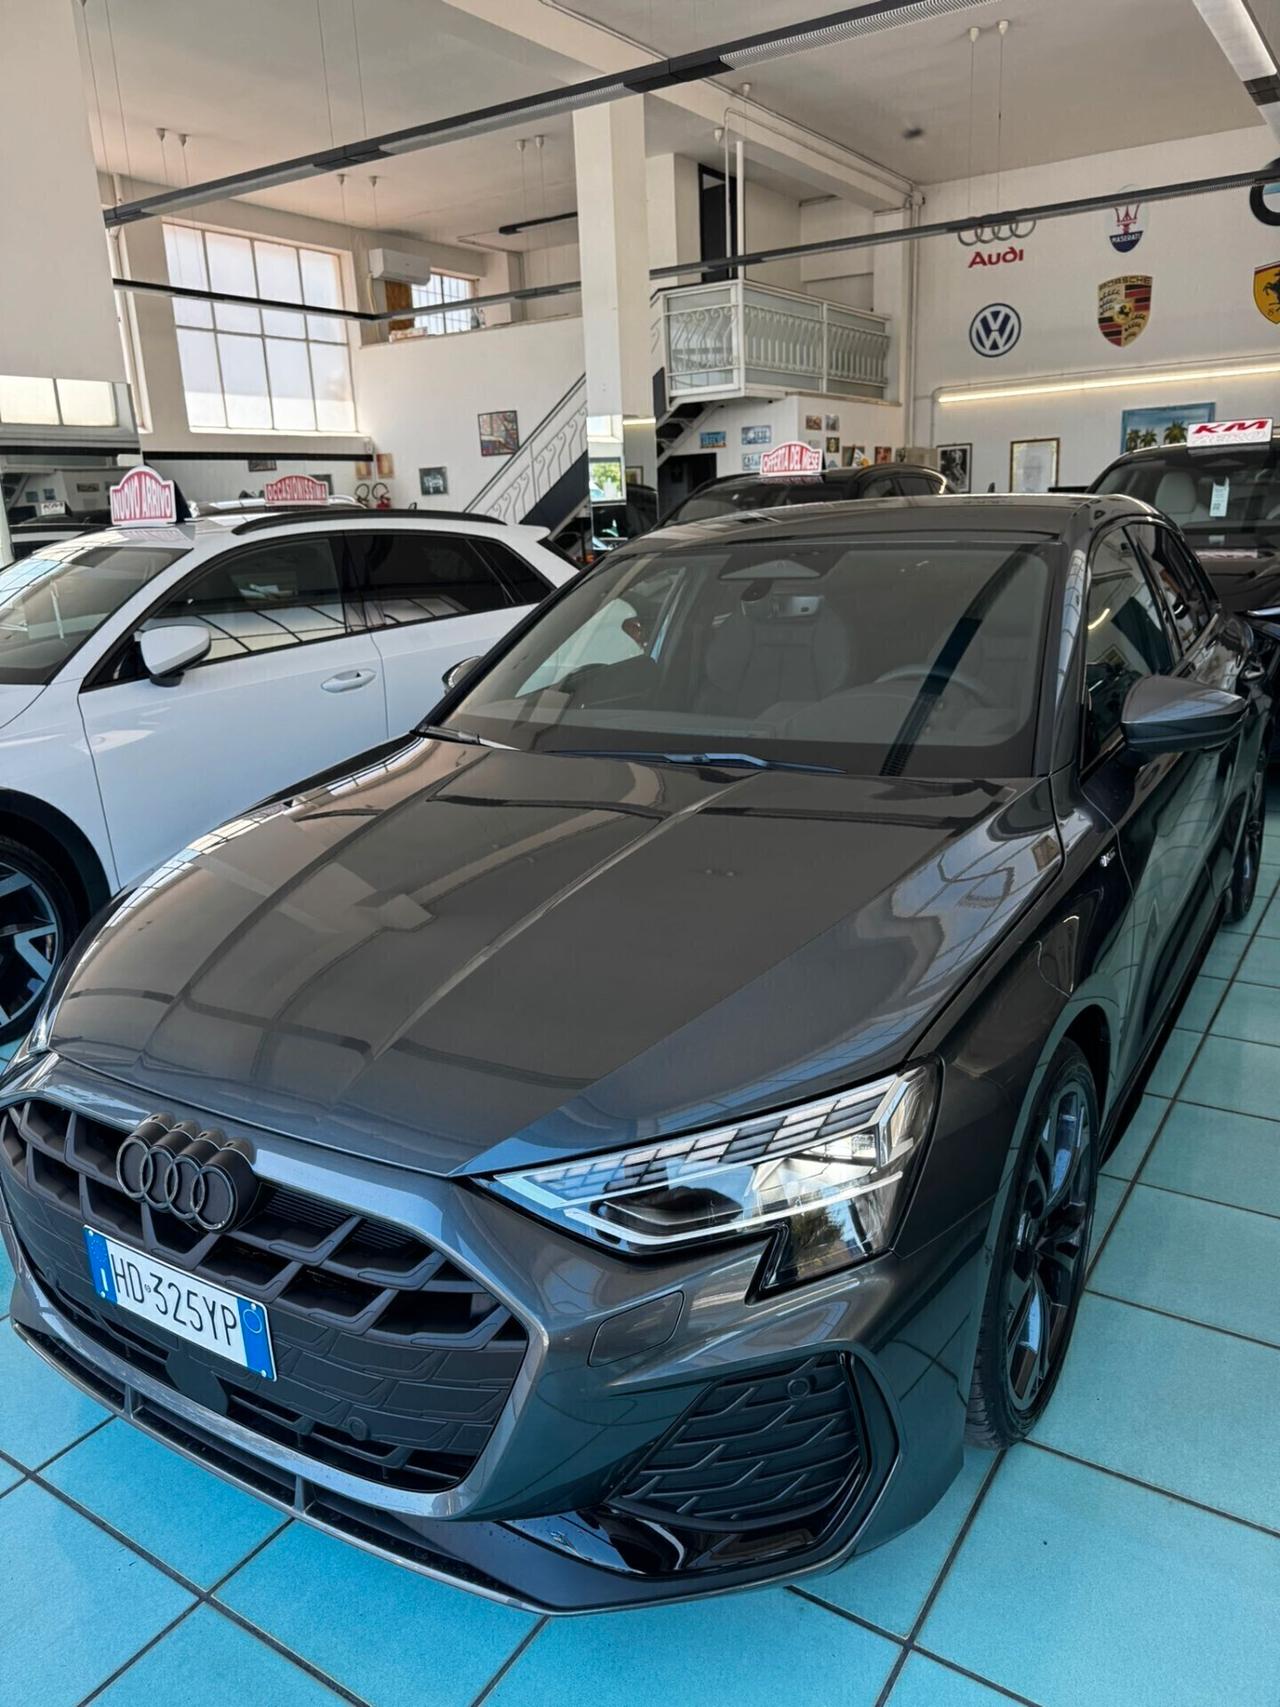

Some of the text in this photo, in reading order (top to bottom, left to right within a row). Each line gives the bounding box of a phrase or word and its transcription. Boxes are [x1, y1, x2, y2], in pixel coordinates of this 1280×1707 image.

[968, 246, 1024, 268] Audi
[1098, 275, 1153, 291] PORSCHE
[1191, 420, 1269, 435] KM
[763, 446, 788, 472] OFFERTA
[789, 445, 801, 470] DEL
[112, 473, 171, 520] NUOVO ARRIVO
